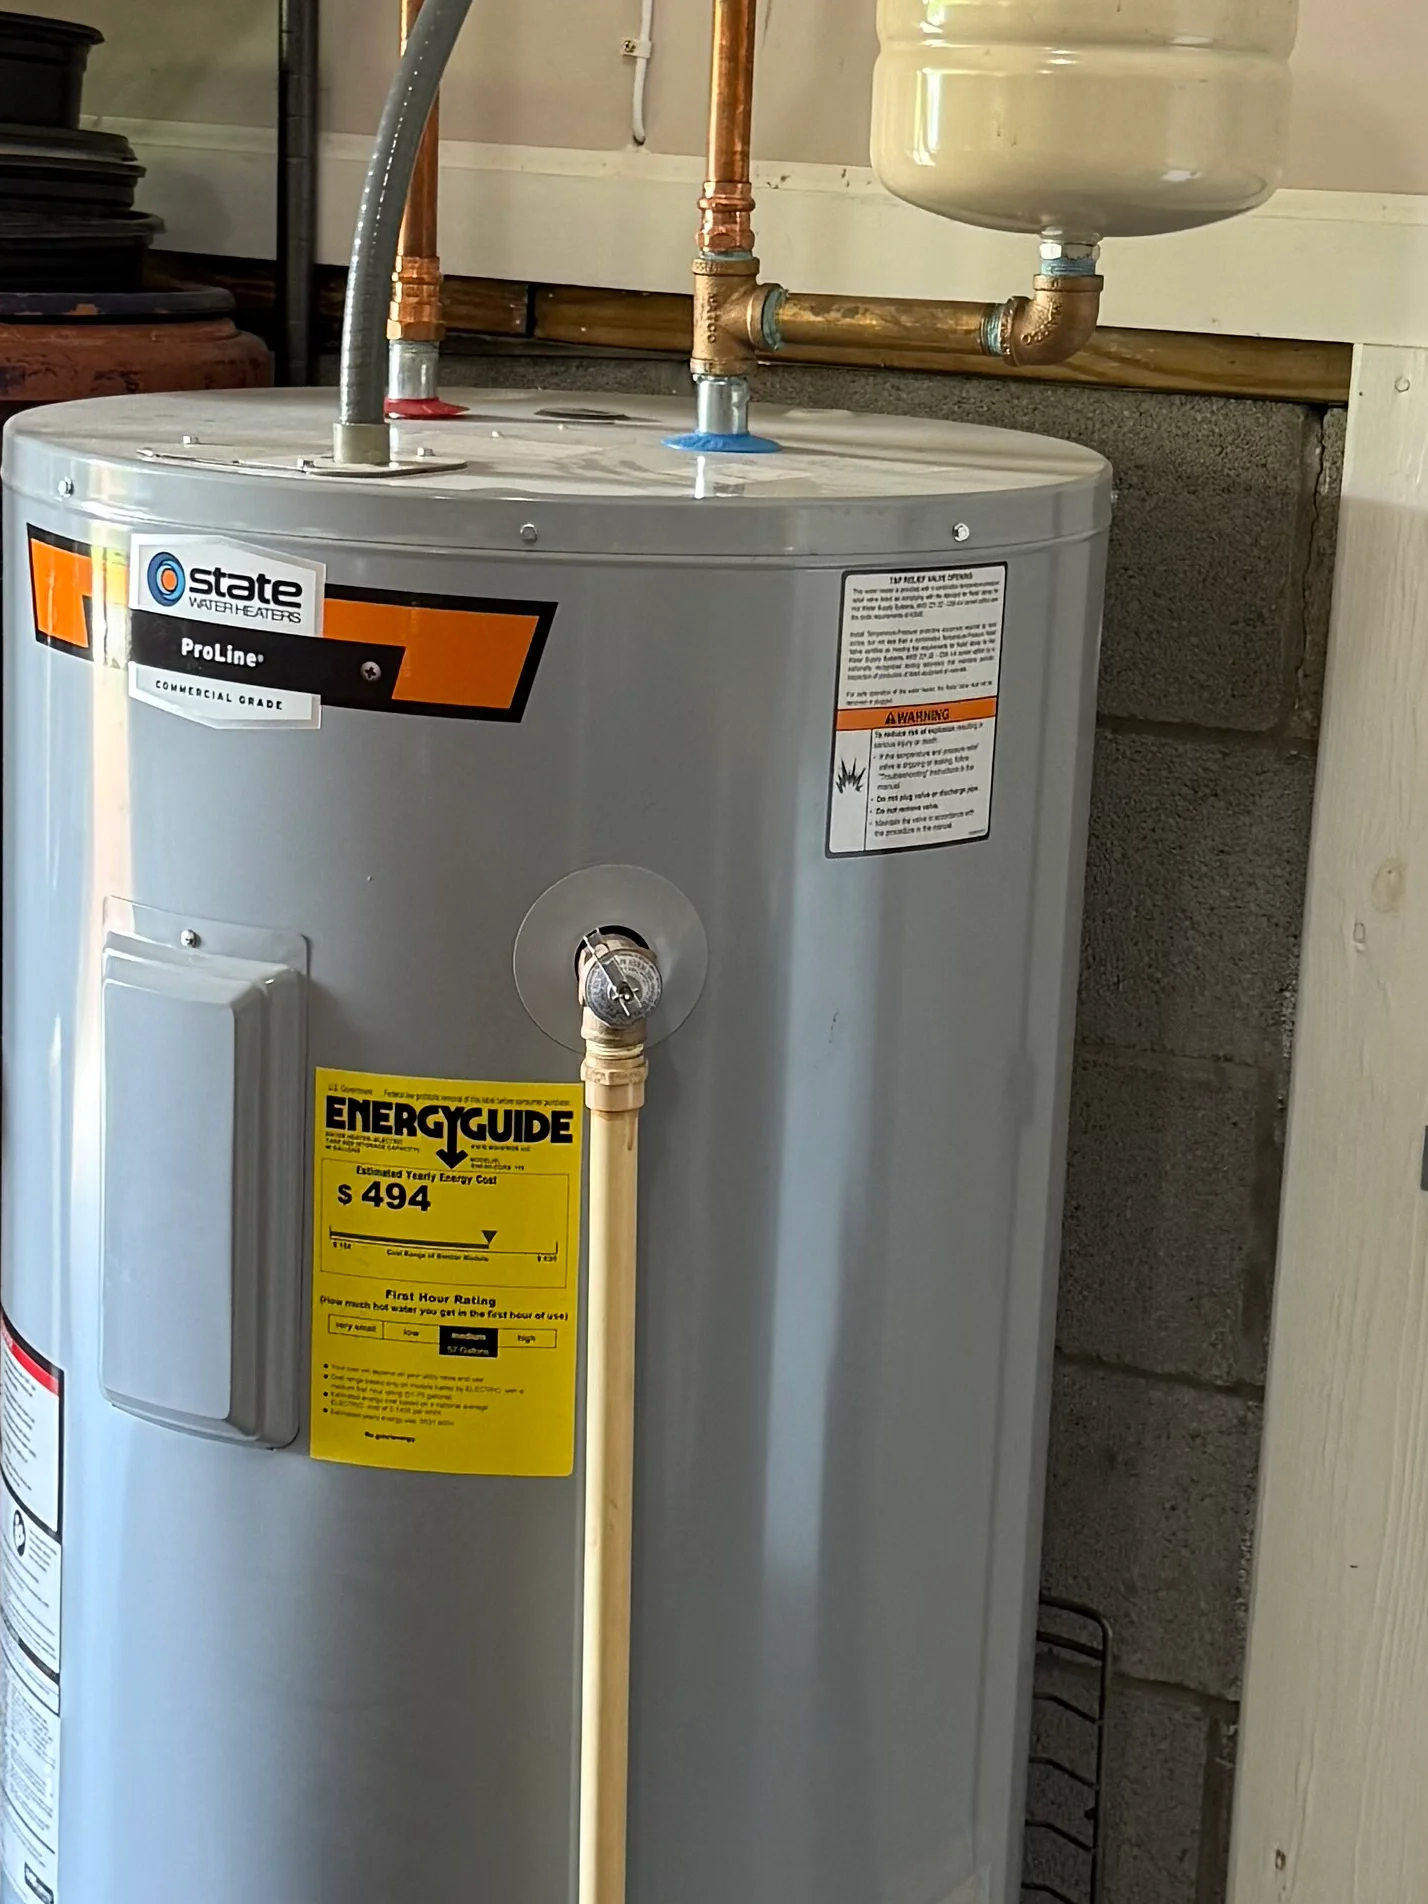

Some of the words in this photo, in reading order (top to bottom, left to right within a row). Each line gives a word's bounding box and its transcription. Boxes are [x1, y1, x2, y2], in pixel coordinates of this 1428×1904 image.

[189, 567, 302, 608] state
[189, 597, 234, 615] WATER
[235, 603, 301, 623] HEATERS
[156, 680, 232, 702] COMMERCIAL
[239, 695, 283, 710] GRADE
[897, 709, 949, 724] WARNING
[325, 1095, 574, 1152] ENERGYGUIDE
[356, 1166, 402, 1178] Estimated
[406, 1171, 436, 1183] Yearly
[440, 1173, 472, 1185] Energy
[476, 1175, 497, 1184] Cost
[338, 1184, 352, 1206] $
[362, 1181, 431, 1211] 494
[320, 1296, 343, 1305] (How
[345, 1300, 371, 1310] much
[373, 1302, 388, 1312] hot
[392, 1305, 417, 1314] water
[420, 1308, 437, 1316] you
[441, 1309, 456, 1318] get
[458, 1309, 467, 1317] in
[470, 1310, 485, 1318] the
[487, 1310, 506, 1319] first
[548, 1313, 568, 1321] use)
[386, 1289, 415, 1300] First
[419, 1293, 449, 1304] Hour
[455, 1295, 496, 1307] Rating
[517, 1334, 536, 1343] high
